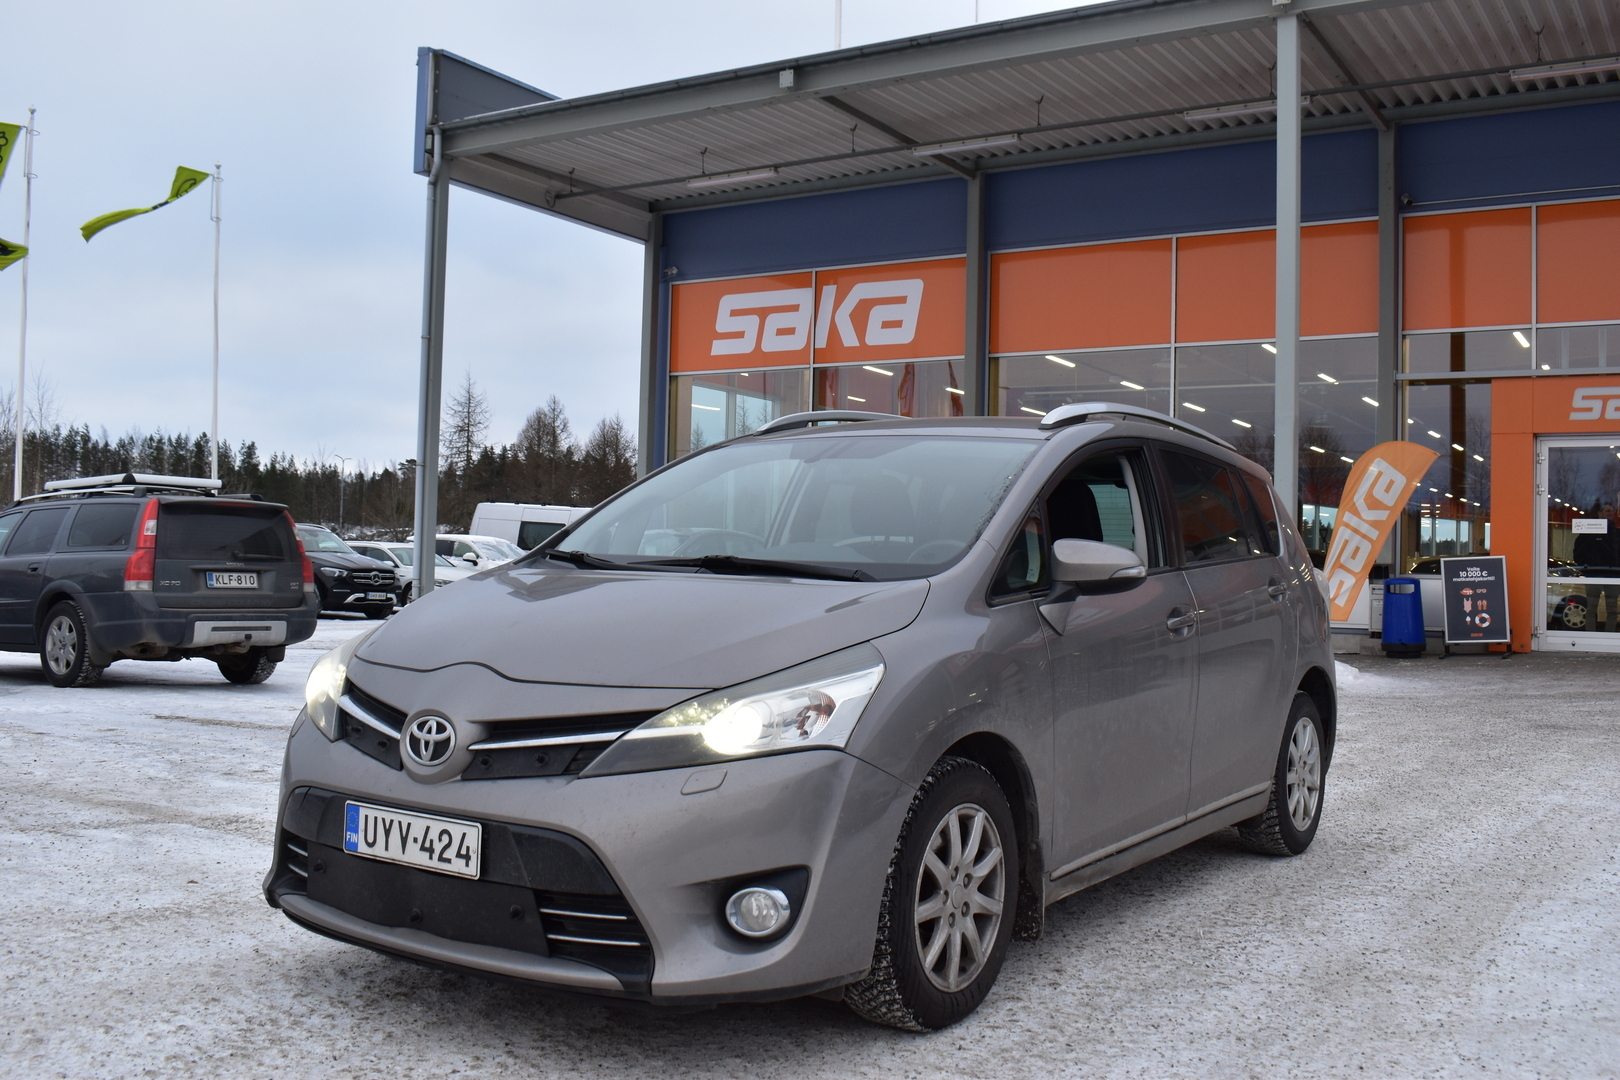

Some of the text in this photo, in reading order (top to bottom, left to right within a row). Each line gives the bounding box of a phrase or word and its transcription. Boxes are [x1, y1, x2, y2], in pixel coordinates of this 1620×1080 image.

[215, 574, 255, 586] KLF-810
[346, 831, 358, 844] FIN
[363, 813, 472, 868] UYV-424
